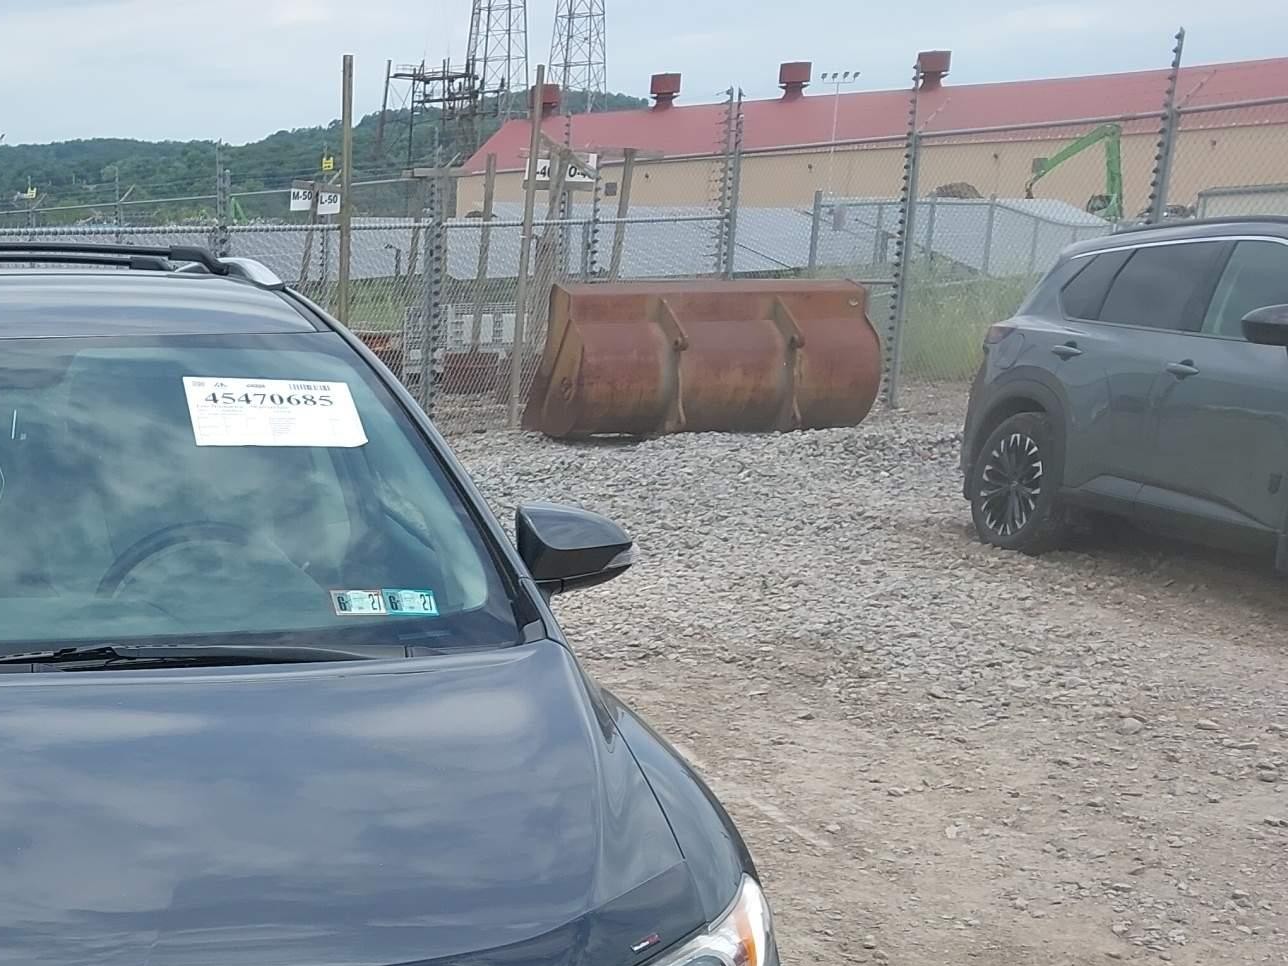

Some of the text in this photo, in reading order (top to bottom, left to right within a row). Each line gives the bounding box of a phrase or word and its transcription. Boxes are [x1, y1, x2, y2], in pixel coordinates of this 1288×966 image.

[292, 191, 312, 201] M-50
[319, 194, 338, 205] L-50
[204, 392, 334, 407] 45470685
